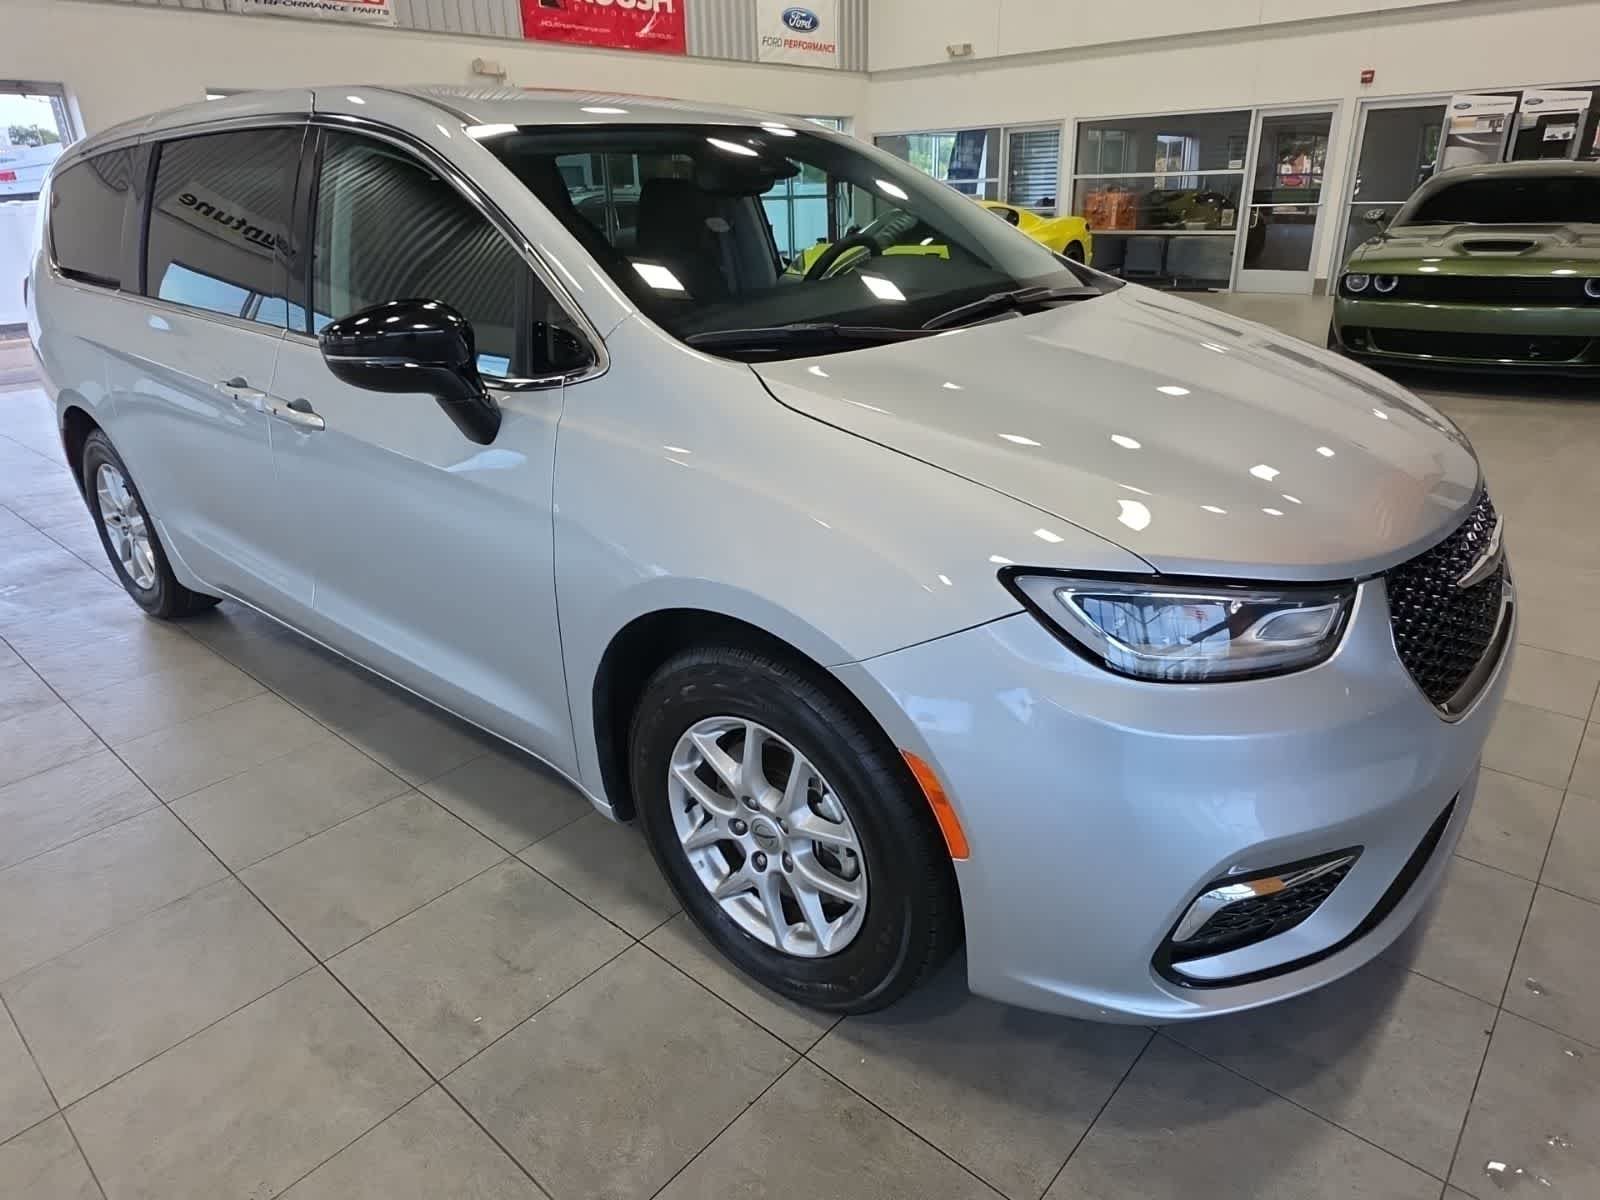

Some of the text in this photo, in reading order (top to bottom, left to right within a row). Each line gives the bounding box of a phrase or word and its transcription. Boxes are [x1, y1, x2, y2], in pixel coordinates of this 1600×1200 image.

[243, 0, 390, 16] RFORMANCE PARTS
[787, 10, 813, 29] Ford
[761, 36, 836, 54] FORD PERFORMANCE
